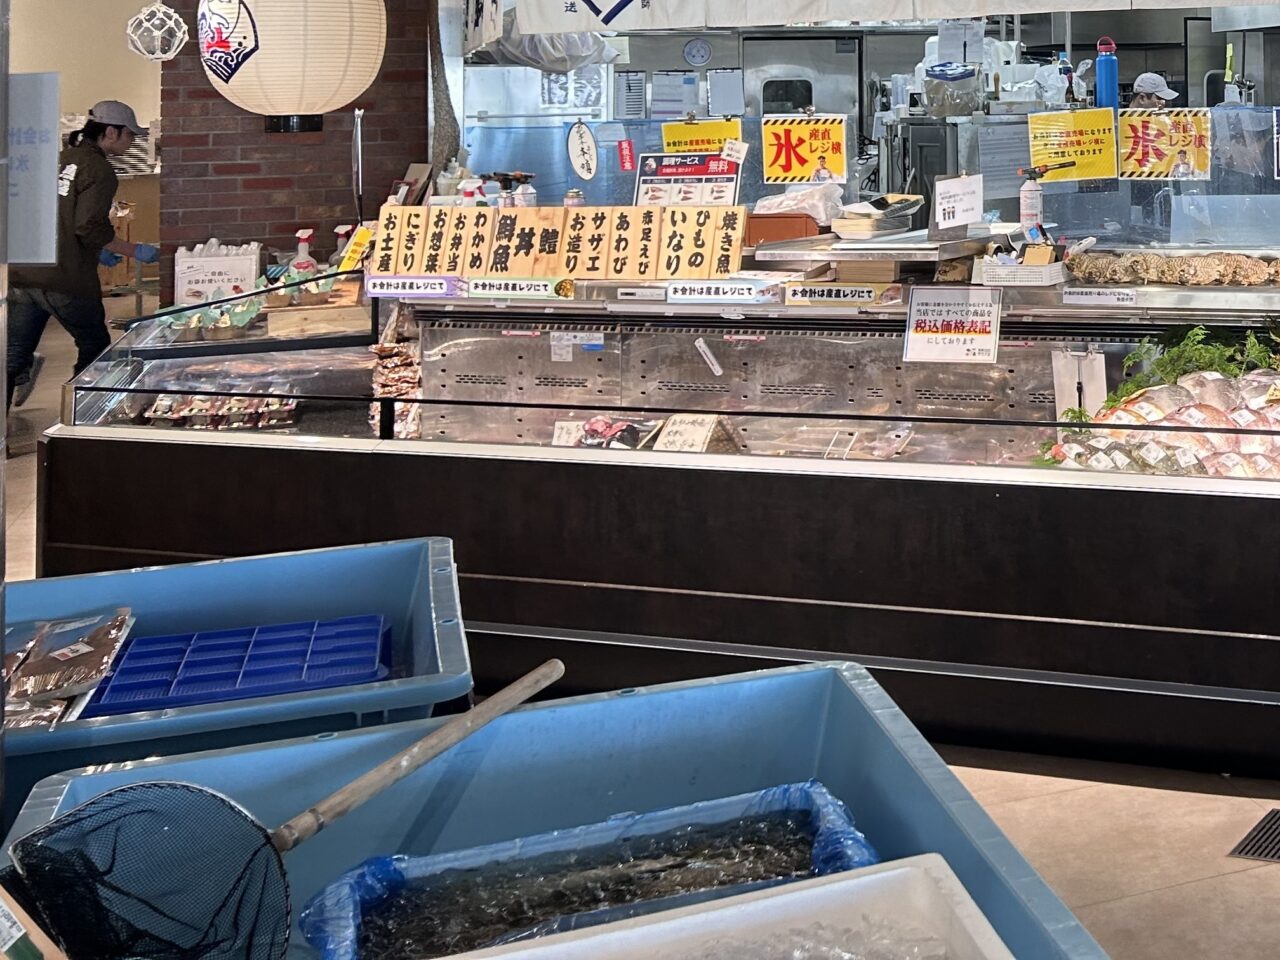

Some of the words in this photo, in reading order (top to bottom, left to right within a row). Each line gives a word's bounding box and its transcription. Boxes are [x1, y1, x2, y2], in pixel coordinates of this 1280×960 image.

[768, 128, 809, 173] 氷
[808, 141, 842, 155] レジ横
[809, 128, 832, 141] 産直
[707, 160, 729, 173] 無料
[377, 212, 397, 272] お土産
[403, 212, 421, 272] にぎり
[424, 209, 447, 273] お惣菜
[446, 212, 467, 272] お弁当
[469, 211, 488, 270] わかめ
[490, 214, 518, 272] 鮮魚
[566, 212, 586, 274] お造り
[586, 211, 607, 272] サザエ
[613, 211, 630, 275] あわび
[638, 210, 654, 275] 赤足えび
[666, 210, 687, 276] いなり
[688, 210, 711, 268] ひもの
[715, 211, 739, 274] 焼き魚
[371, 281, 446, 291] お会計は産直レジにて
[472, 280, 550, 292] お会計は産直レジにて
[672, 285, 753, 296] お会計は産直レジにて
[791, 288, 873, 299] お会計は産直レジにて
[914, 319, 992, 335] 税込価格表記
[927, 337, 976, 345] にしております
